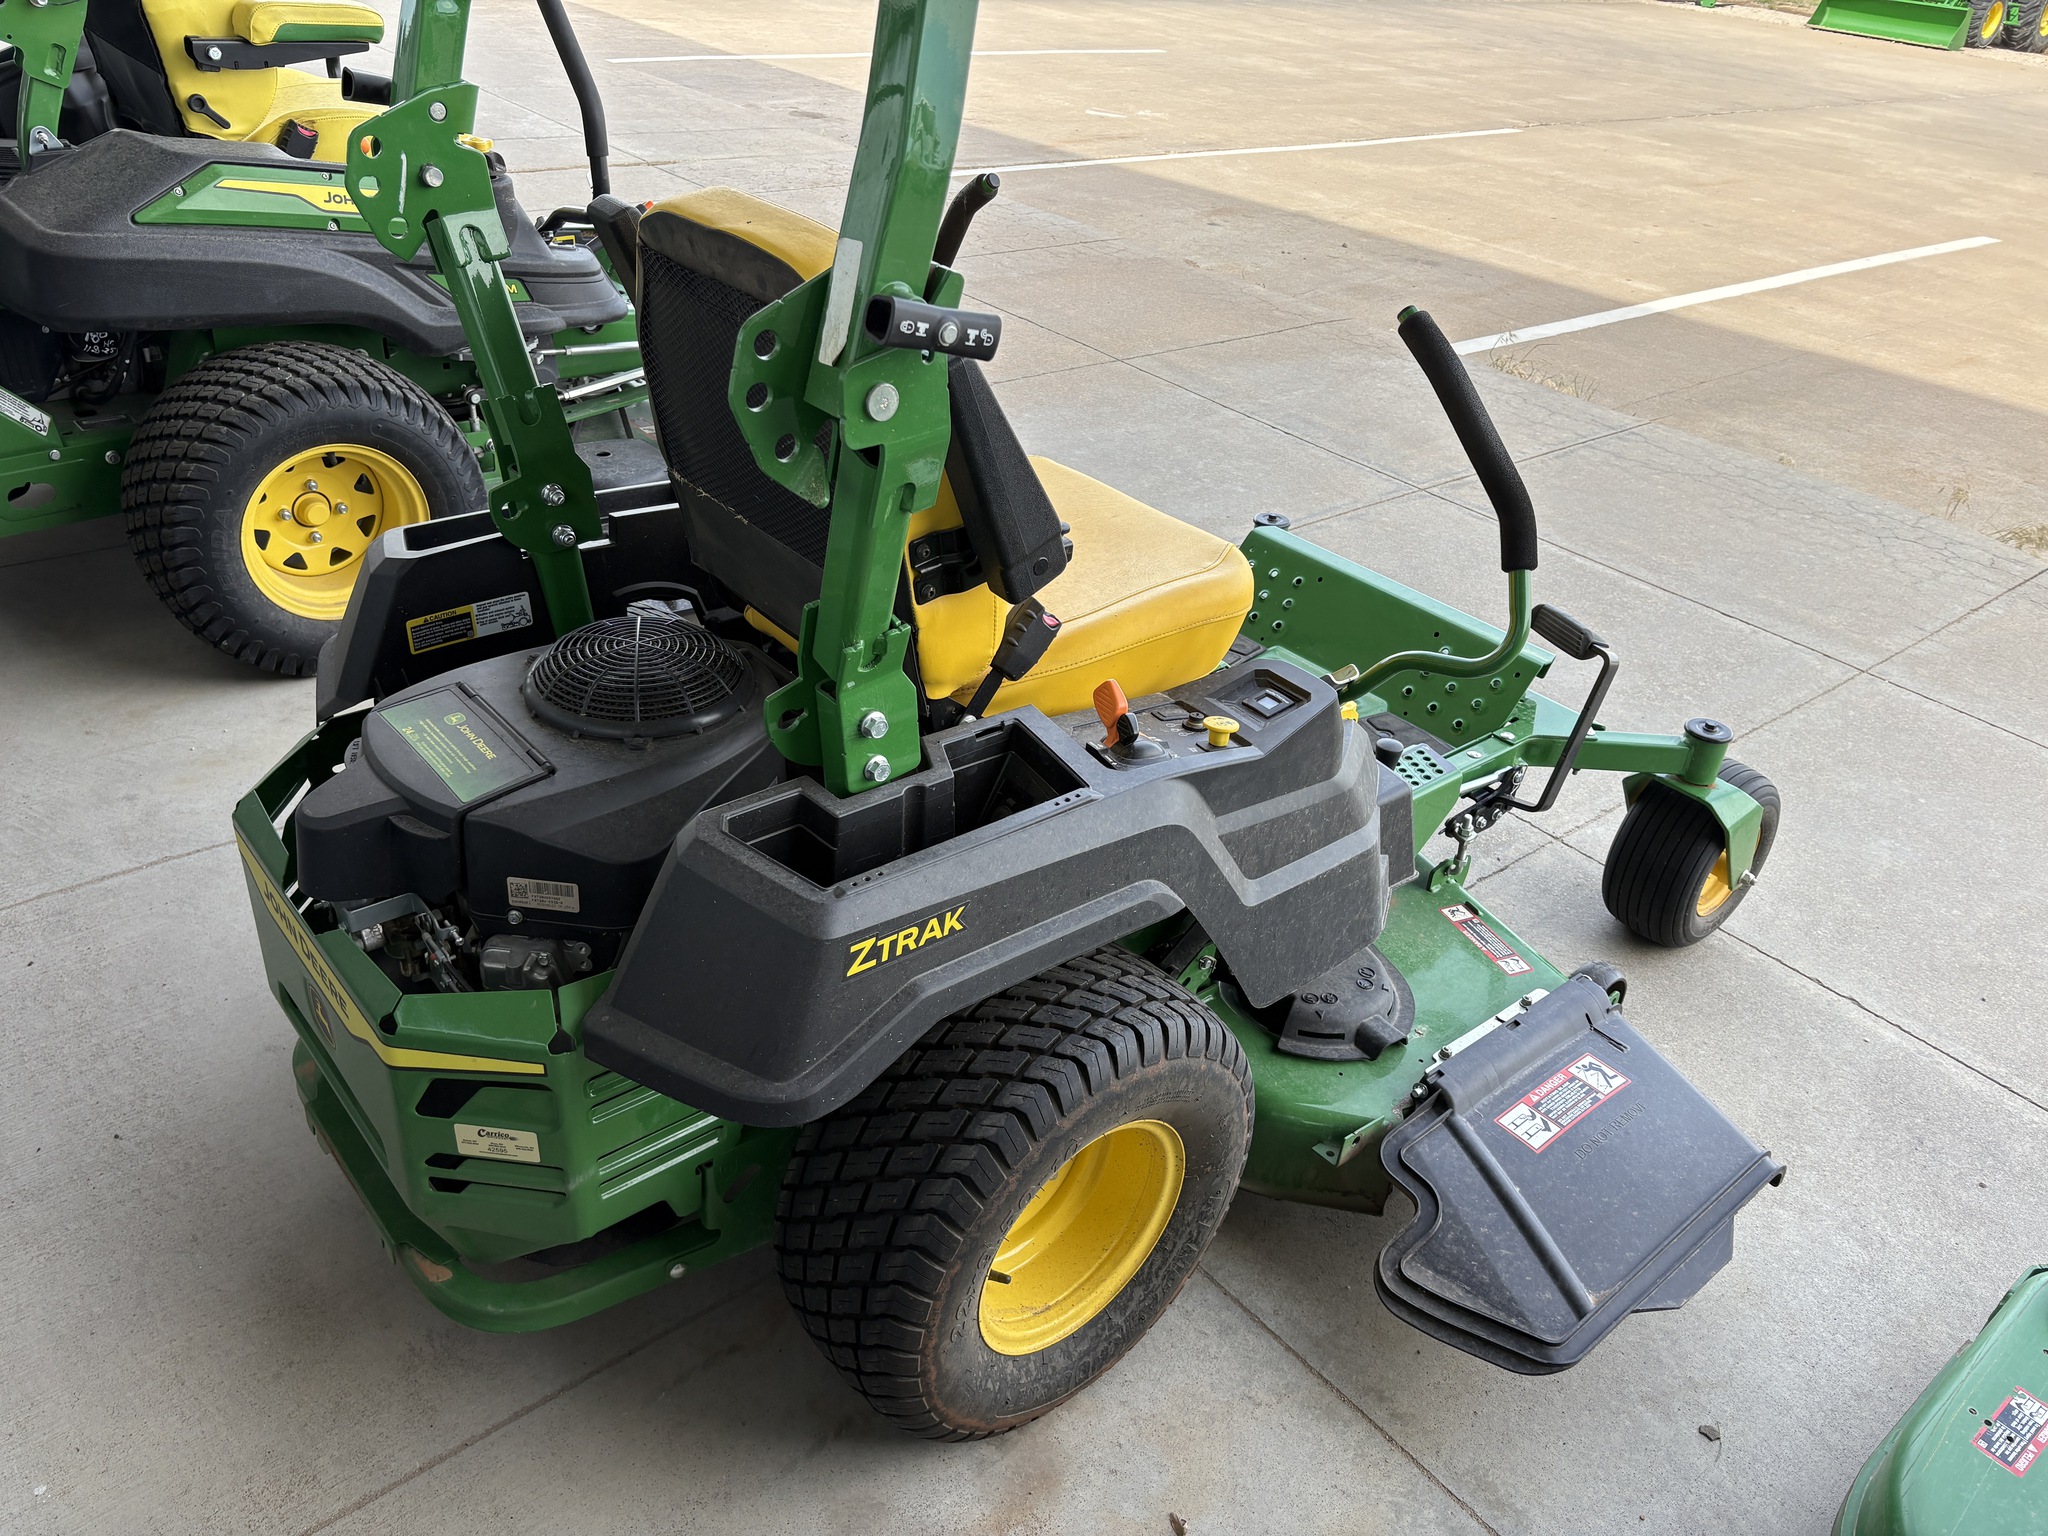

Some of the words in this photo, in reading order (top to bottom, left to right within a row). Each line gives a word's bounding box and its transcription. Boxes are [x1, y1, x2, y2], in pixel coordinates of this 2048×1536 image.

[324, 191, 355, 205] JOH
[429, 610, 457, 621] CAUTION
[456, 724, 478, 741] JOHN
[474, 738, 497, 760] DEERE
[263, 881, 299, 944] JOHN
[298, 931, 350, 1020] DEERE
[847, 905, 966, 977] ZTRAK
[1535, 1072, 1567, 1097] DANGER
[477, 1128, 509, 1138] Carrico
[1574, 1142, 1593, 1160] DO
[1590, 1127, 1613, 1148] NOT
